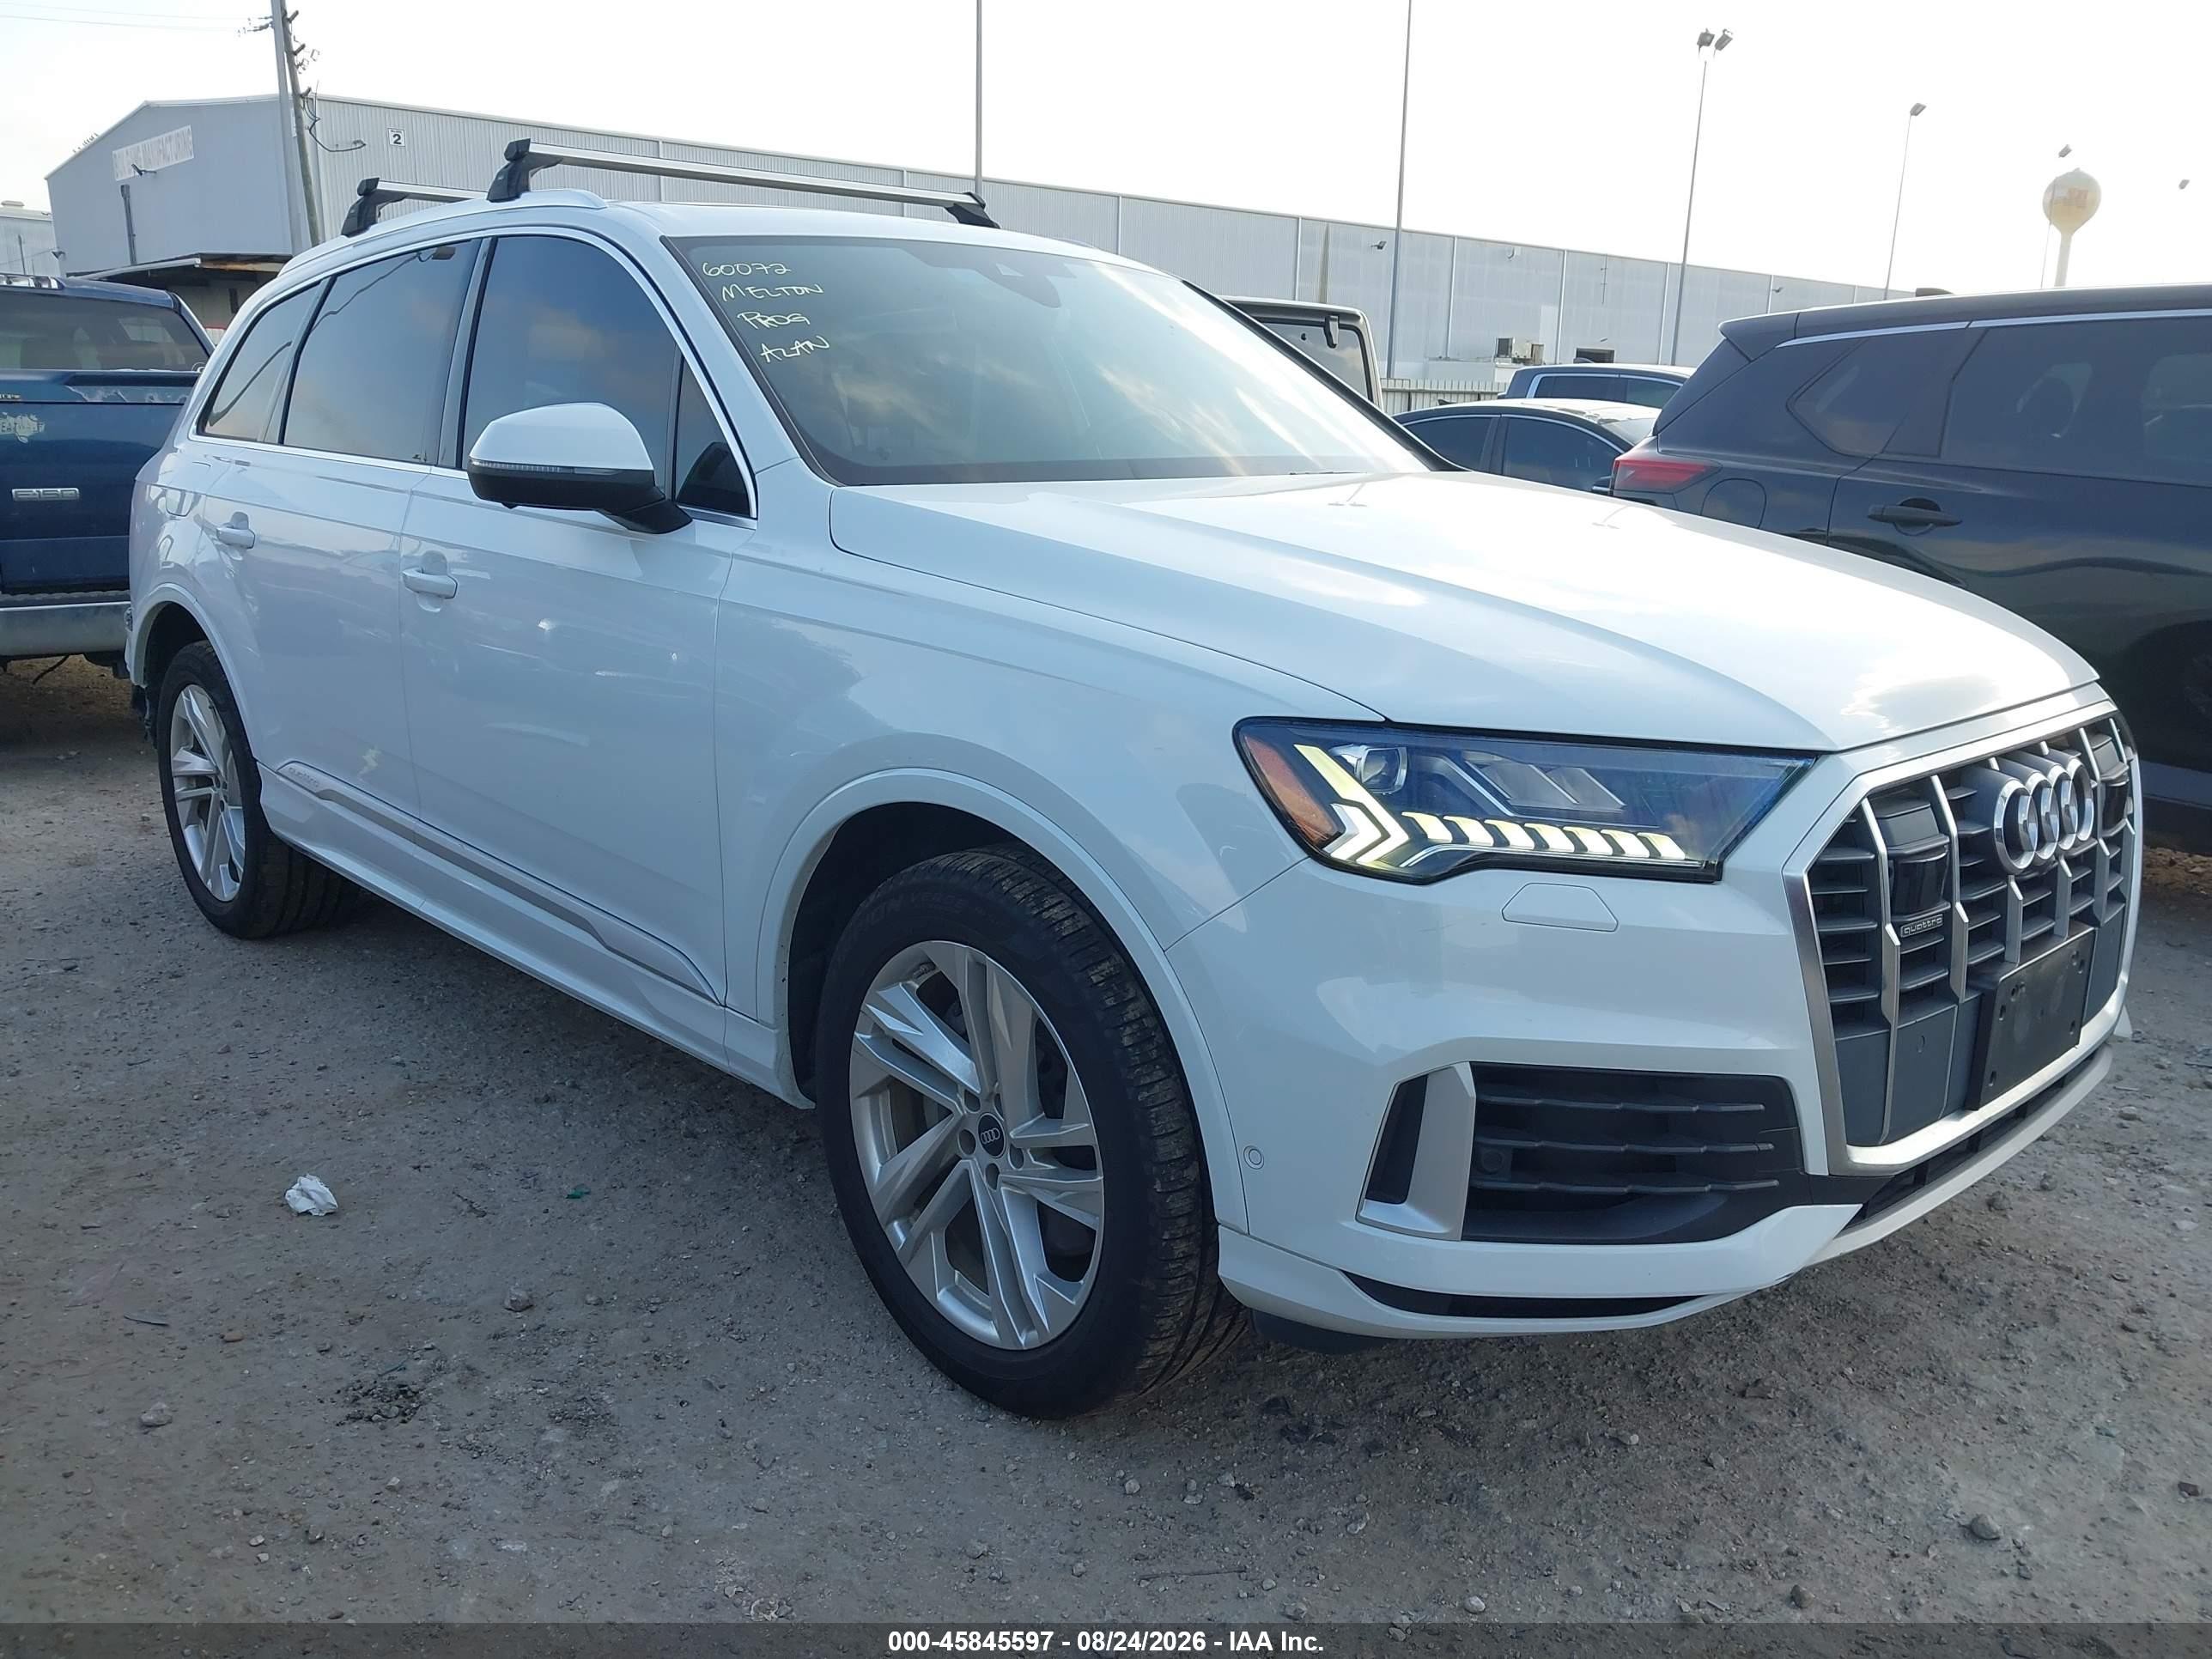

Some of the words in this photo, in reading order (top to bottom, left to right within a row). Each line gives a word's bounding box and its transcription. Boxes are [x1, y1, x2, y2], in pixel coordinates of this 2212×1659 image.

[392, 133, 402, 145] 2
[702, 262, 791, 276] 60072
[721, 283, 824, 301] MELTON
[1903, 916, 1943, 936] quattro
